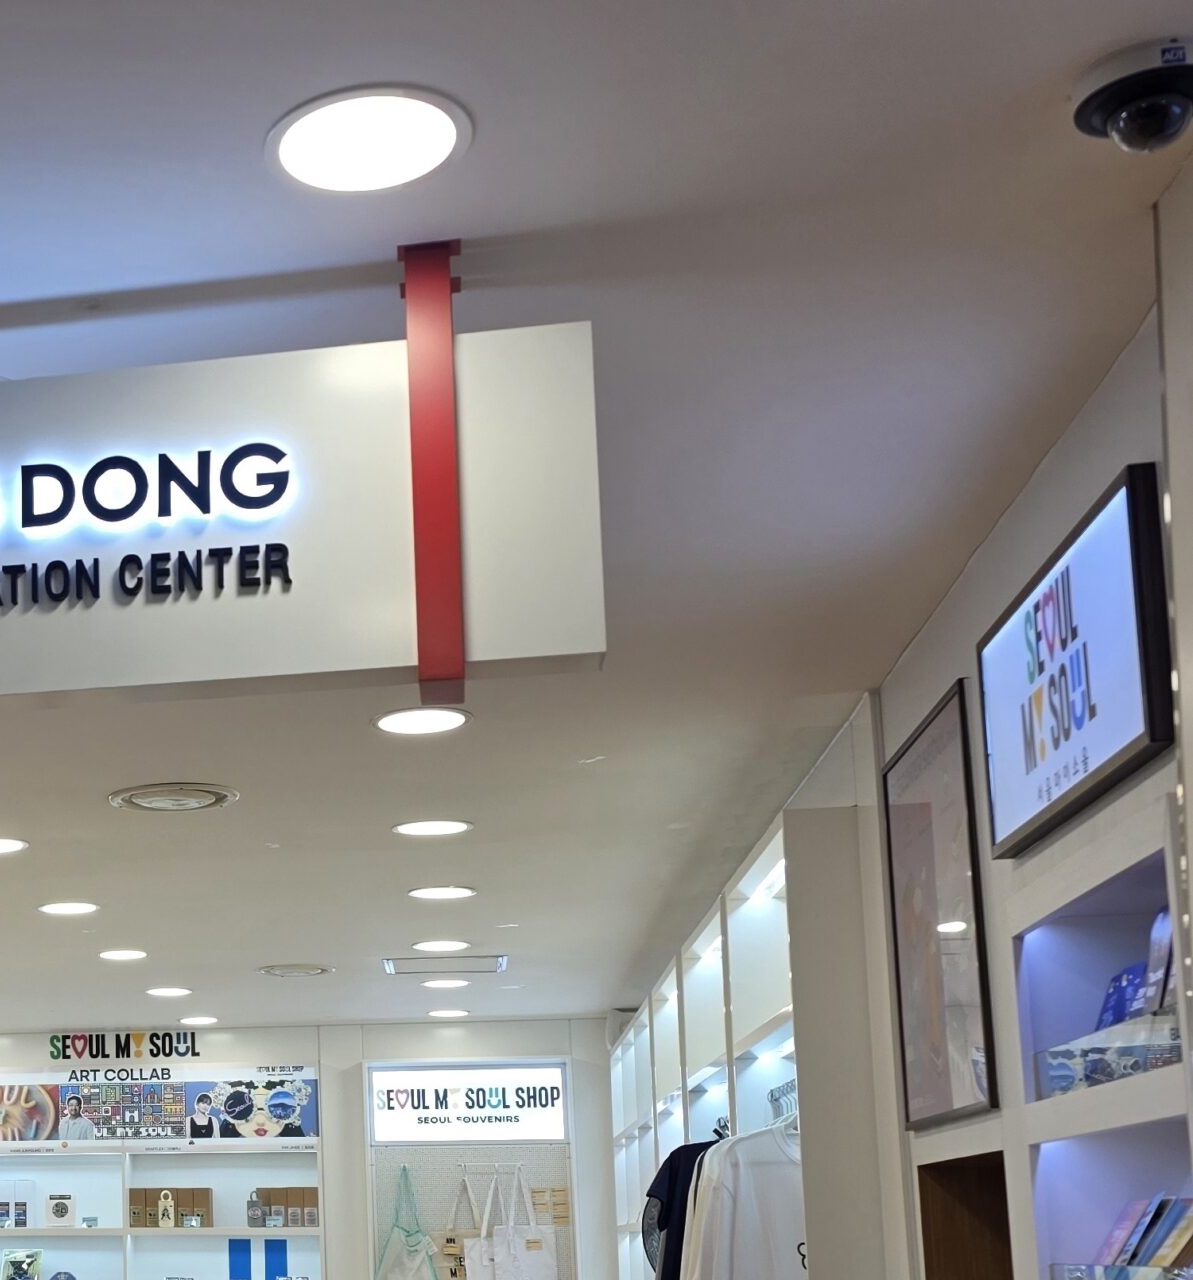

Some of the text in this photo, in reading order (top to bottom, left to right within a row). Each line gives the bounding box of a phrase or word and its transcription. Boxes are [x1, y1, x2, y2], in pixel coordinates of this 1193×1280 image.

[20, 443, 290, 528] DONG
[117, 542, 292, 595] CENTER
[149, 1032, 200, 1058] SOUL
[68, 1068, 171, 1082] ART COLLAB
[465, 1087, 510, 1109] SOUL
[515, 1086, 561, 1109] SHOP
[417, 1115, 520, 1124] SEOUL SOUVENIRS
